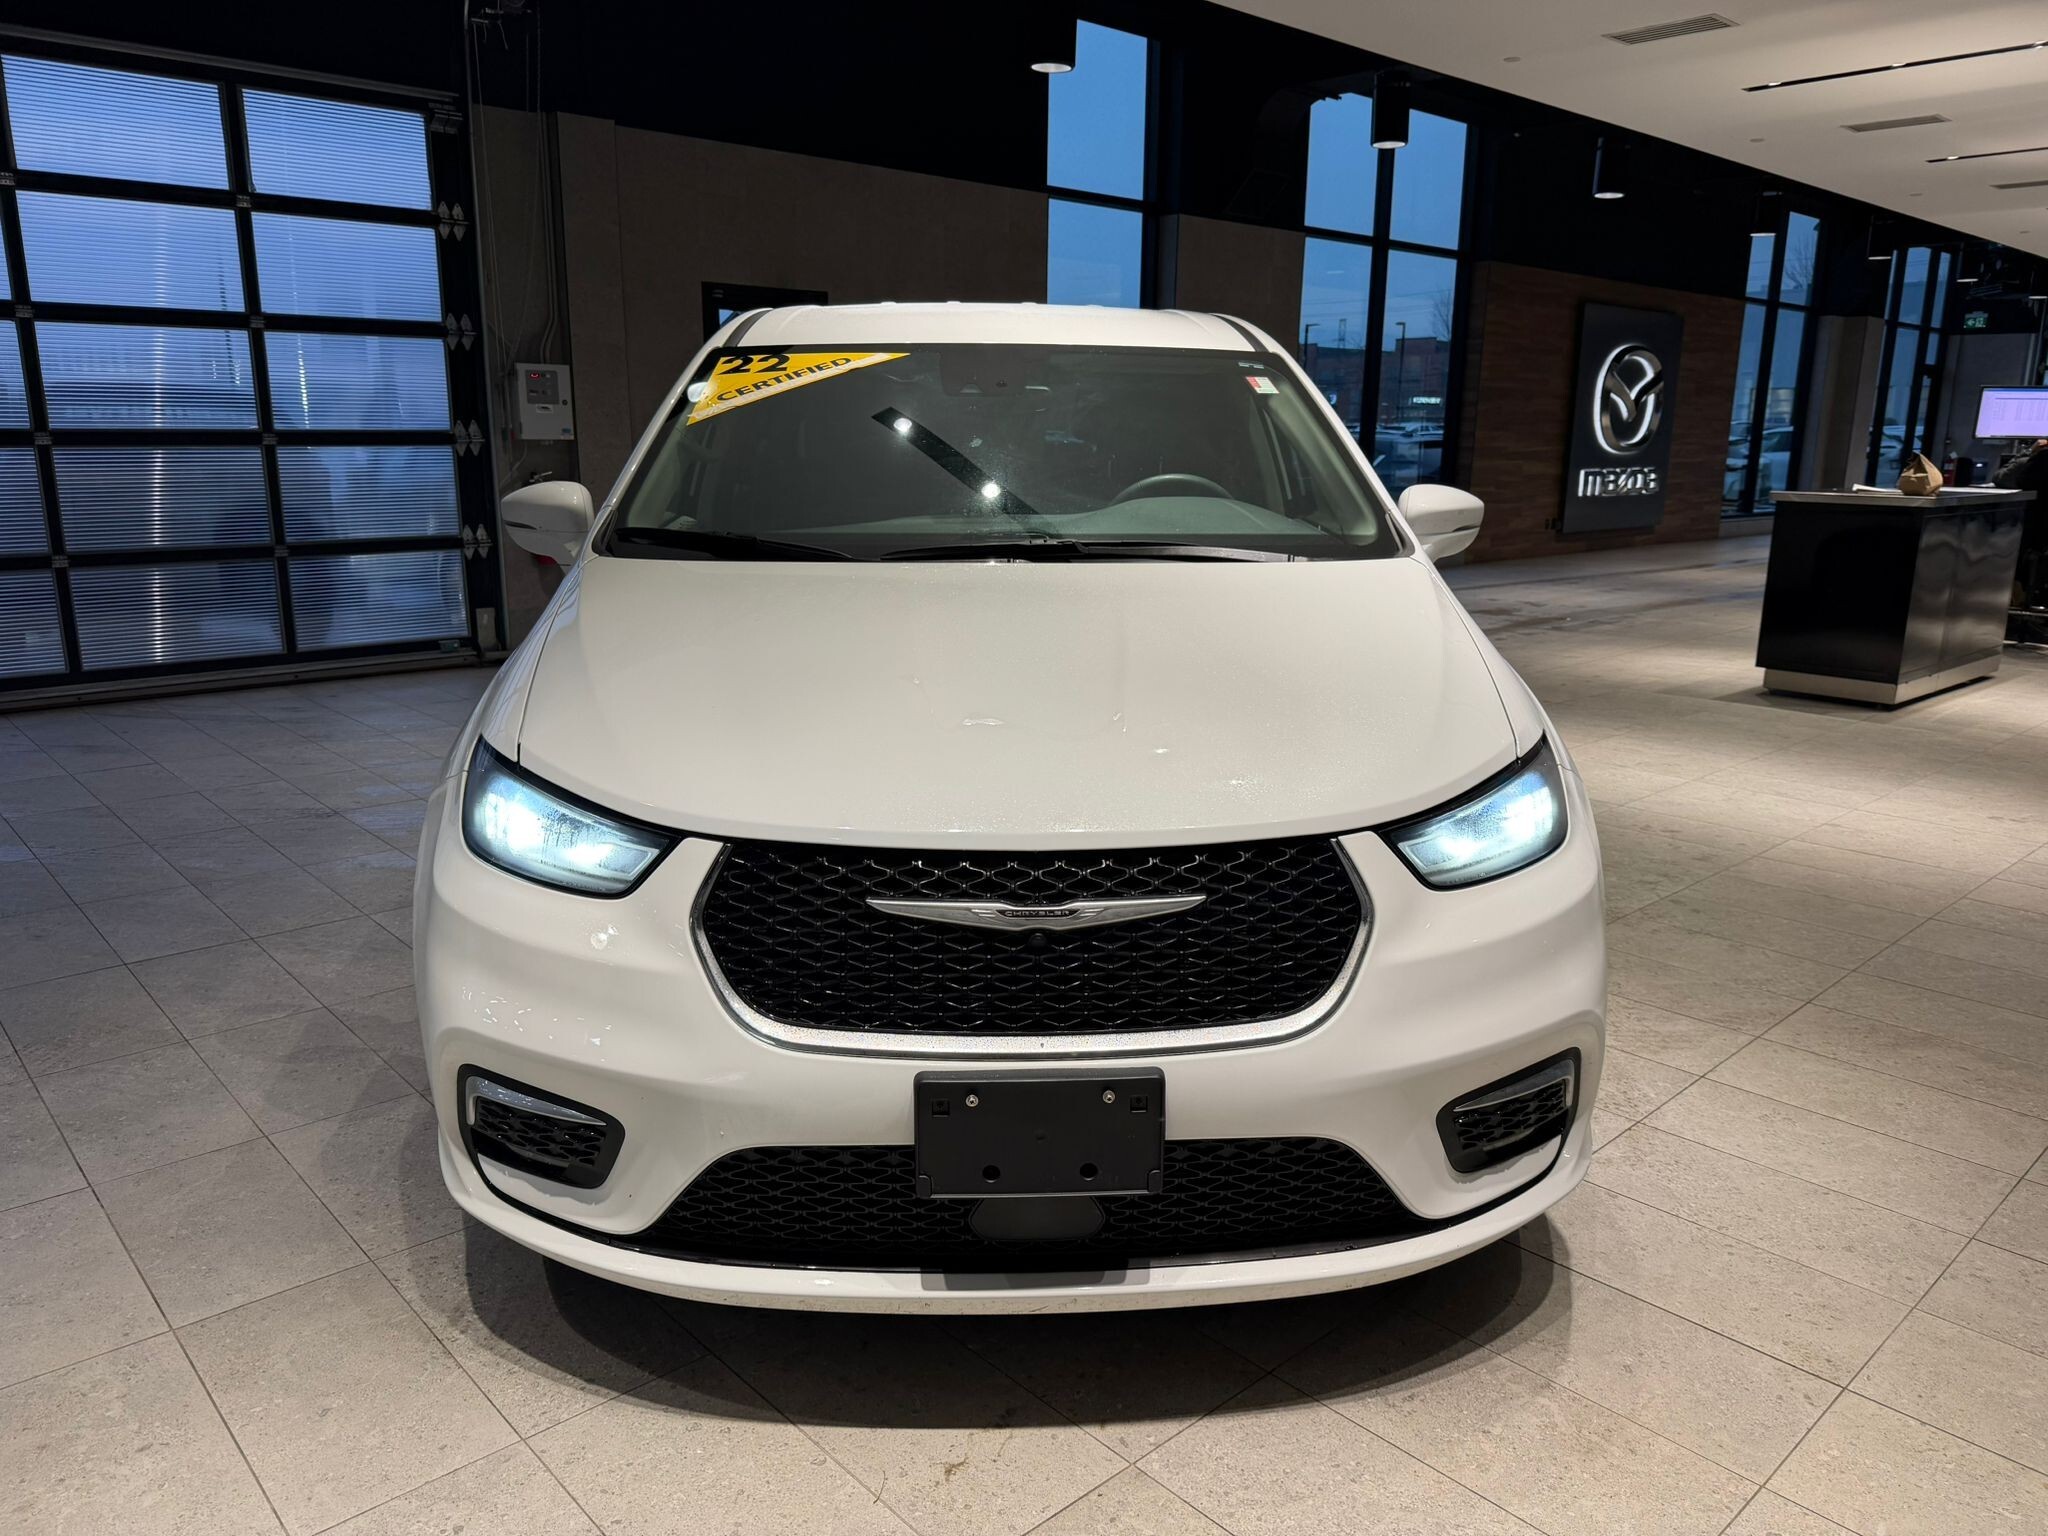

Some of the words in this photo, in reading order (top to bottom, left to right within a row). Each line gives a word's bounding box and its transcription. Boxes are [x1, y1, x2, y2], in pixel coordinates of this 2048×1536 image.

[717, 354, 791, 375] 22
[716, 357, 853, 402] CERTIFIED
[1004, 909, 1070, 917] CHRYSLER
